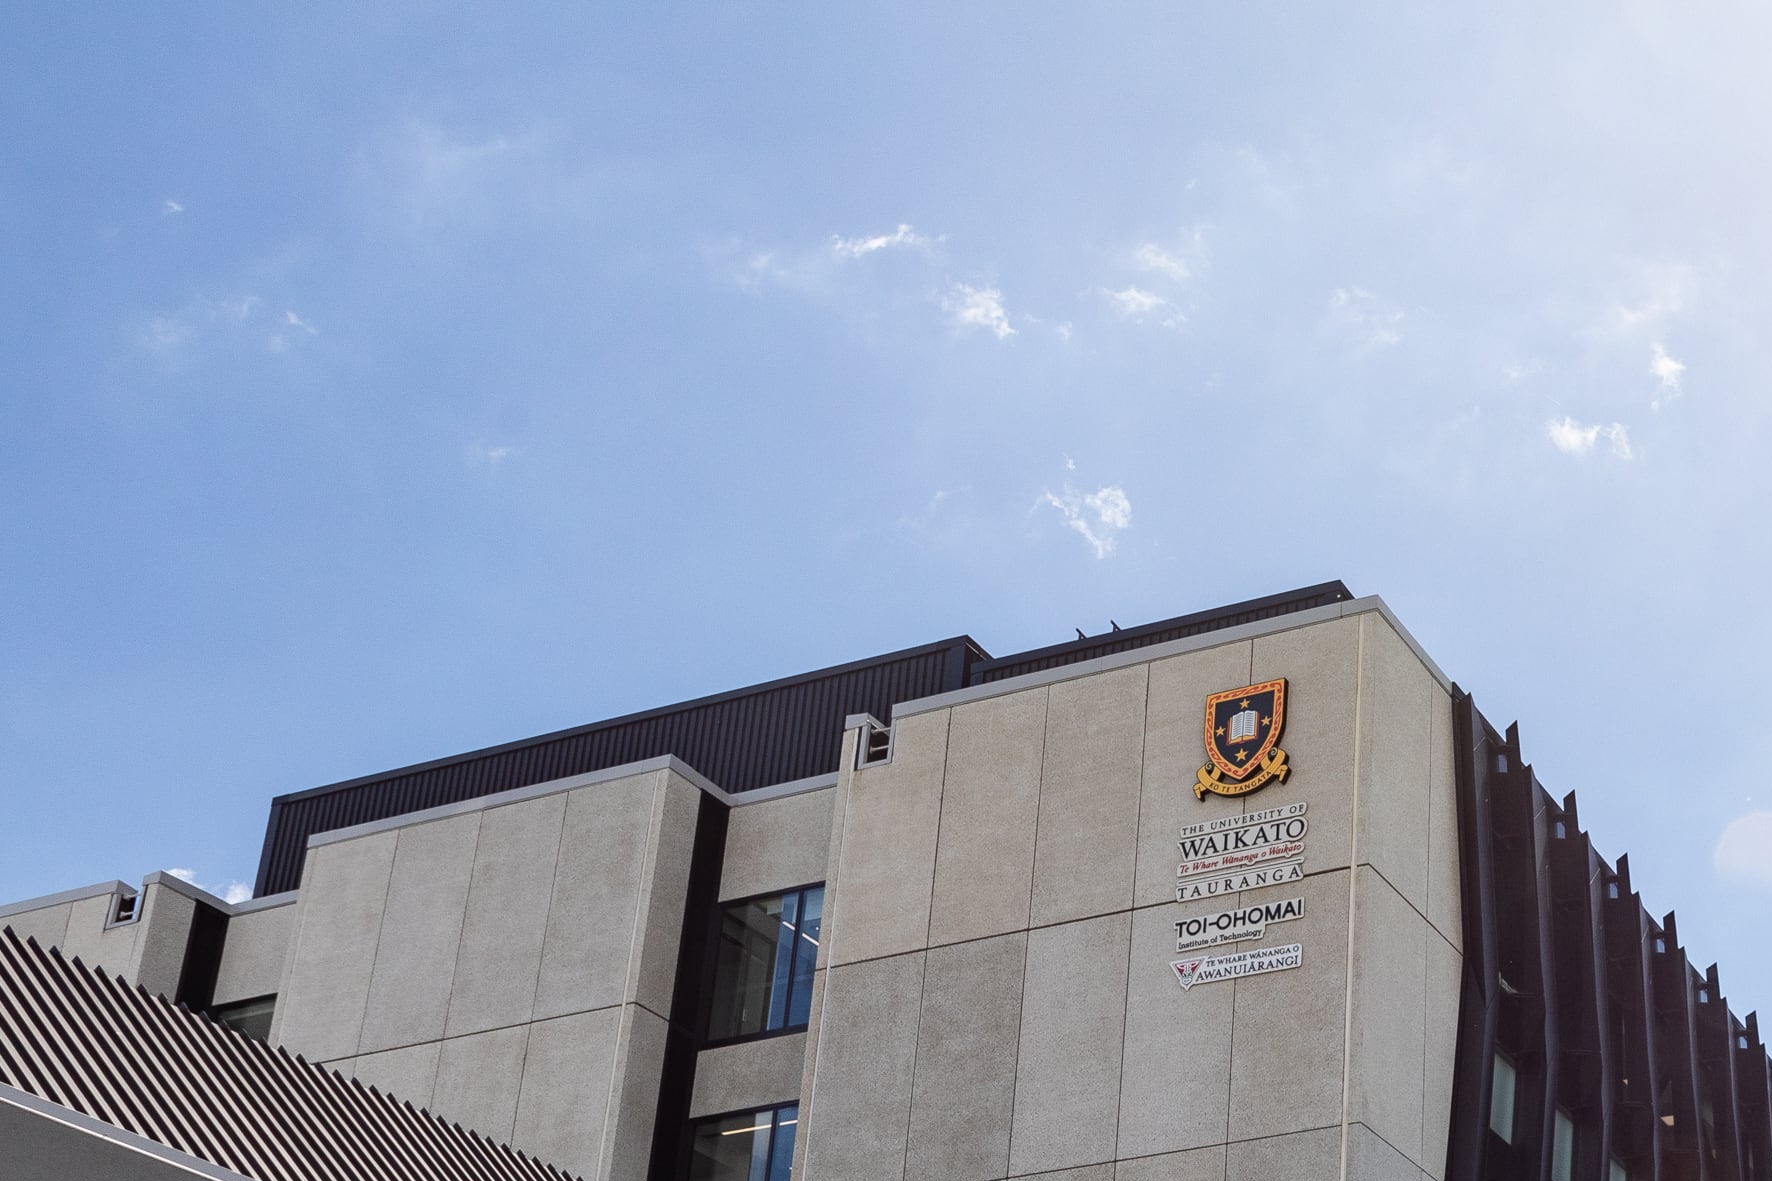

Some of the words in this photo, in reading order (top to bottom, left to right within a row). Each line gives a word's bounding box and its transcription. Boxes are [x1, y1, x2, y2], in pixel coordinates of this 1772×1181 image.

[1209, 782, 1219, 790] KO
[1234, 771, 1272, 792] TANGATA
[1182, 824, 1205, 836] THE
[1210, 808, 1283, 830] UNIVERSITY
[1289, 804, 1304, 814] OF
[1179, 818, 1305, 859] WAIKATO
[1180, 865, 1189, 874] Te
[1192, 861, 1219, 870] Whare
[1269, 844, 1301, 856] Waikato
[1177, 865, 1300, 899] TAURANGA
[1175, 899, 1302, 938] TOI-OHOMAI
[1178, 940, 1209, 950] Institute
[1210, 936, 1218, 944] of
[1220, 929, 1262, 942] Technology
[1215, 954, 1247, 965] WHARE
